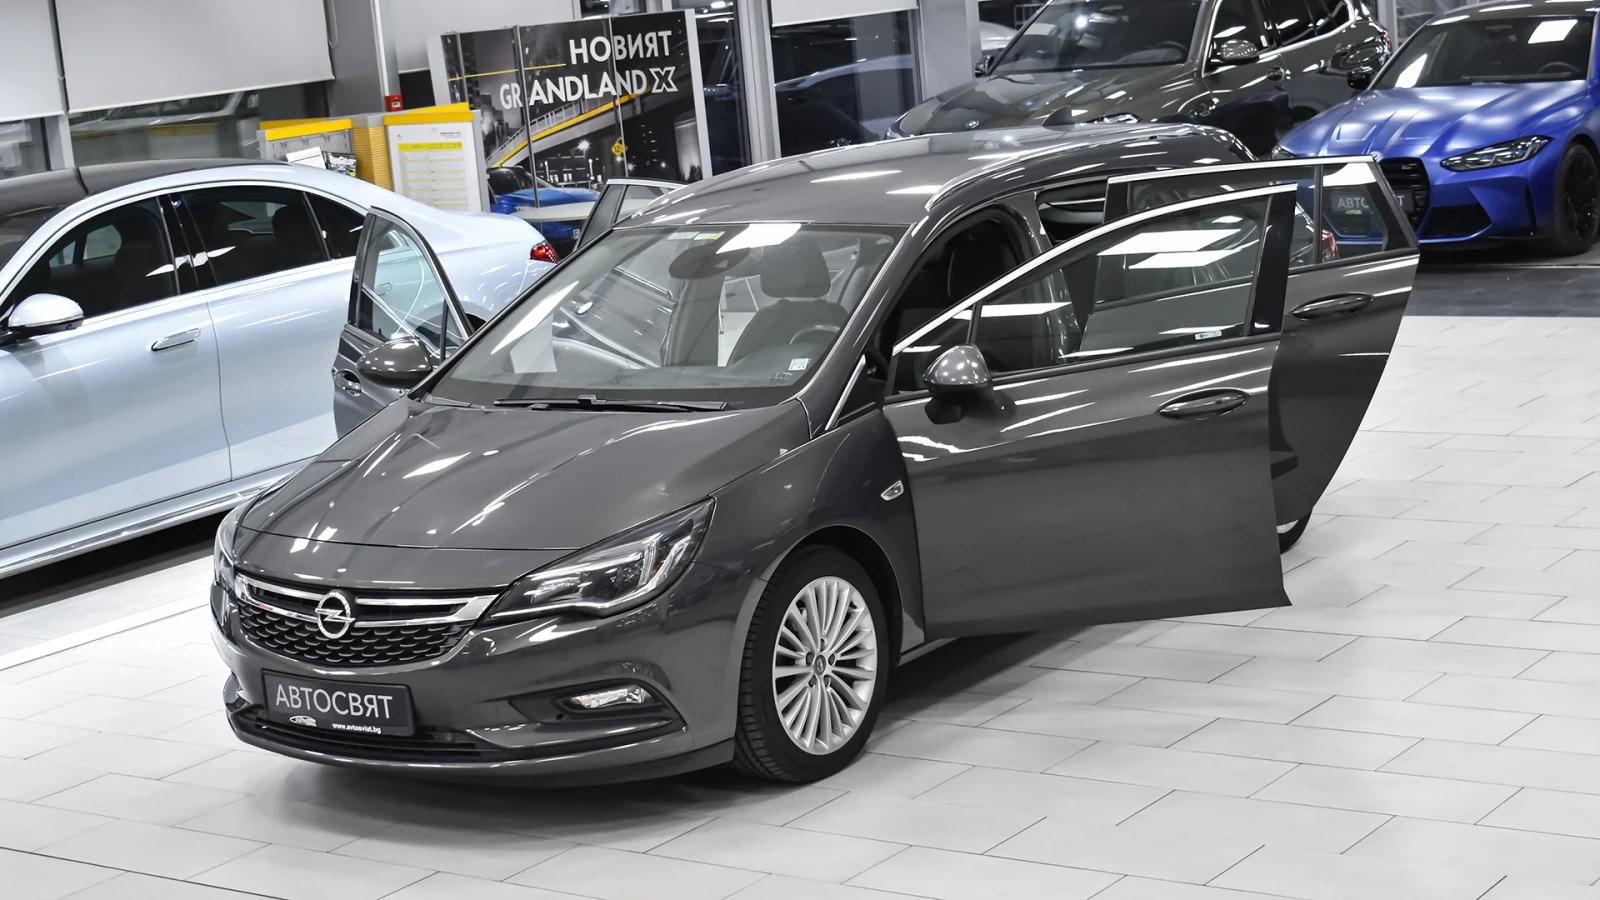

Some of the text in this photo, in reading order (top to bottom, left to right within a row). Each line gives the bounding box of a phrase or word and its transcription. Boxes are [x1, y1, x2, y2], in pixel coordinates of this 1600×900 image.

[569, 30, 672, 65] НОВИЯТ
[499, 66, 679, 110] GRANDLAND X
[276, 684, 393, 719] АВТОСВЯТ
[332, 723, 382, 735] www.avtosviat.bg
